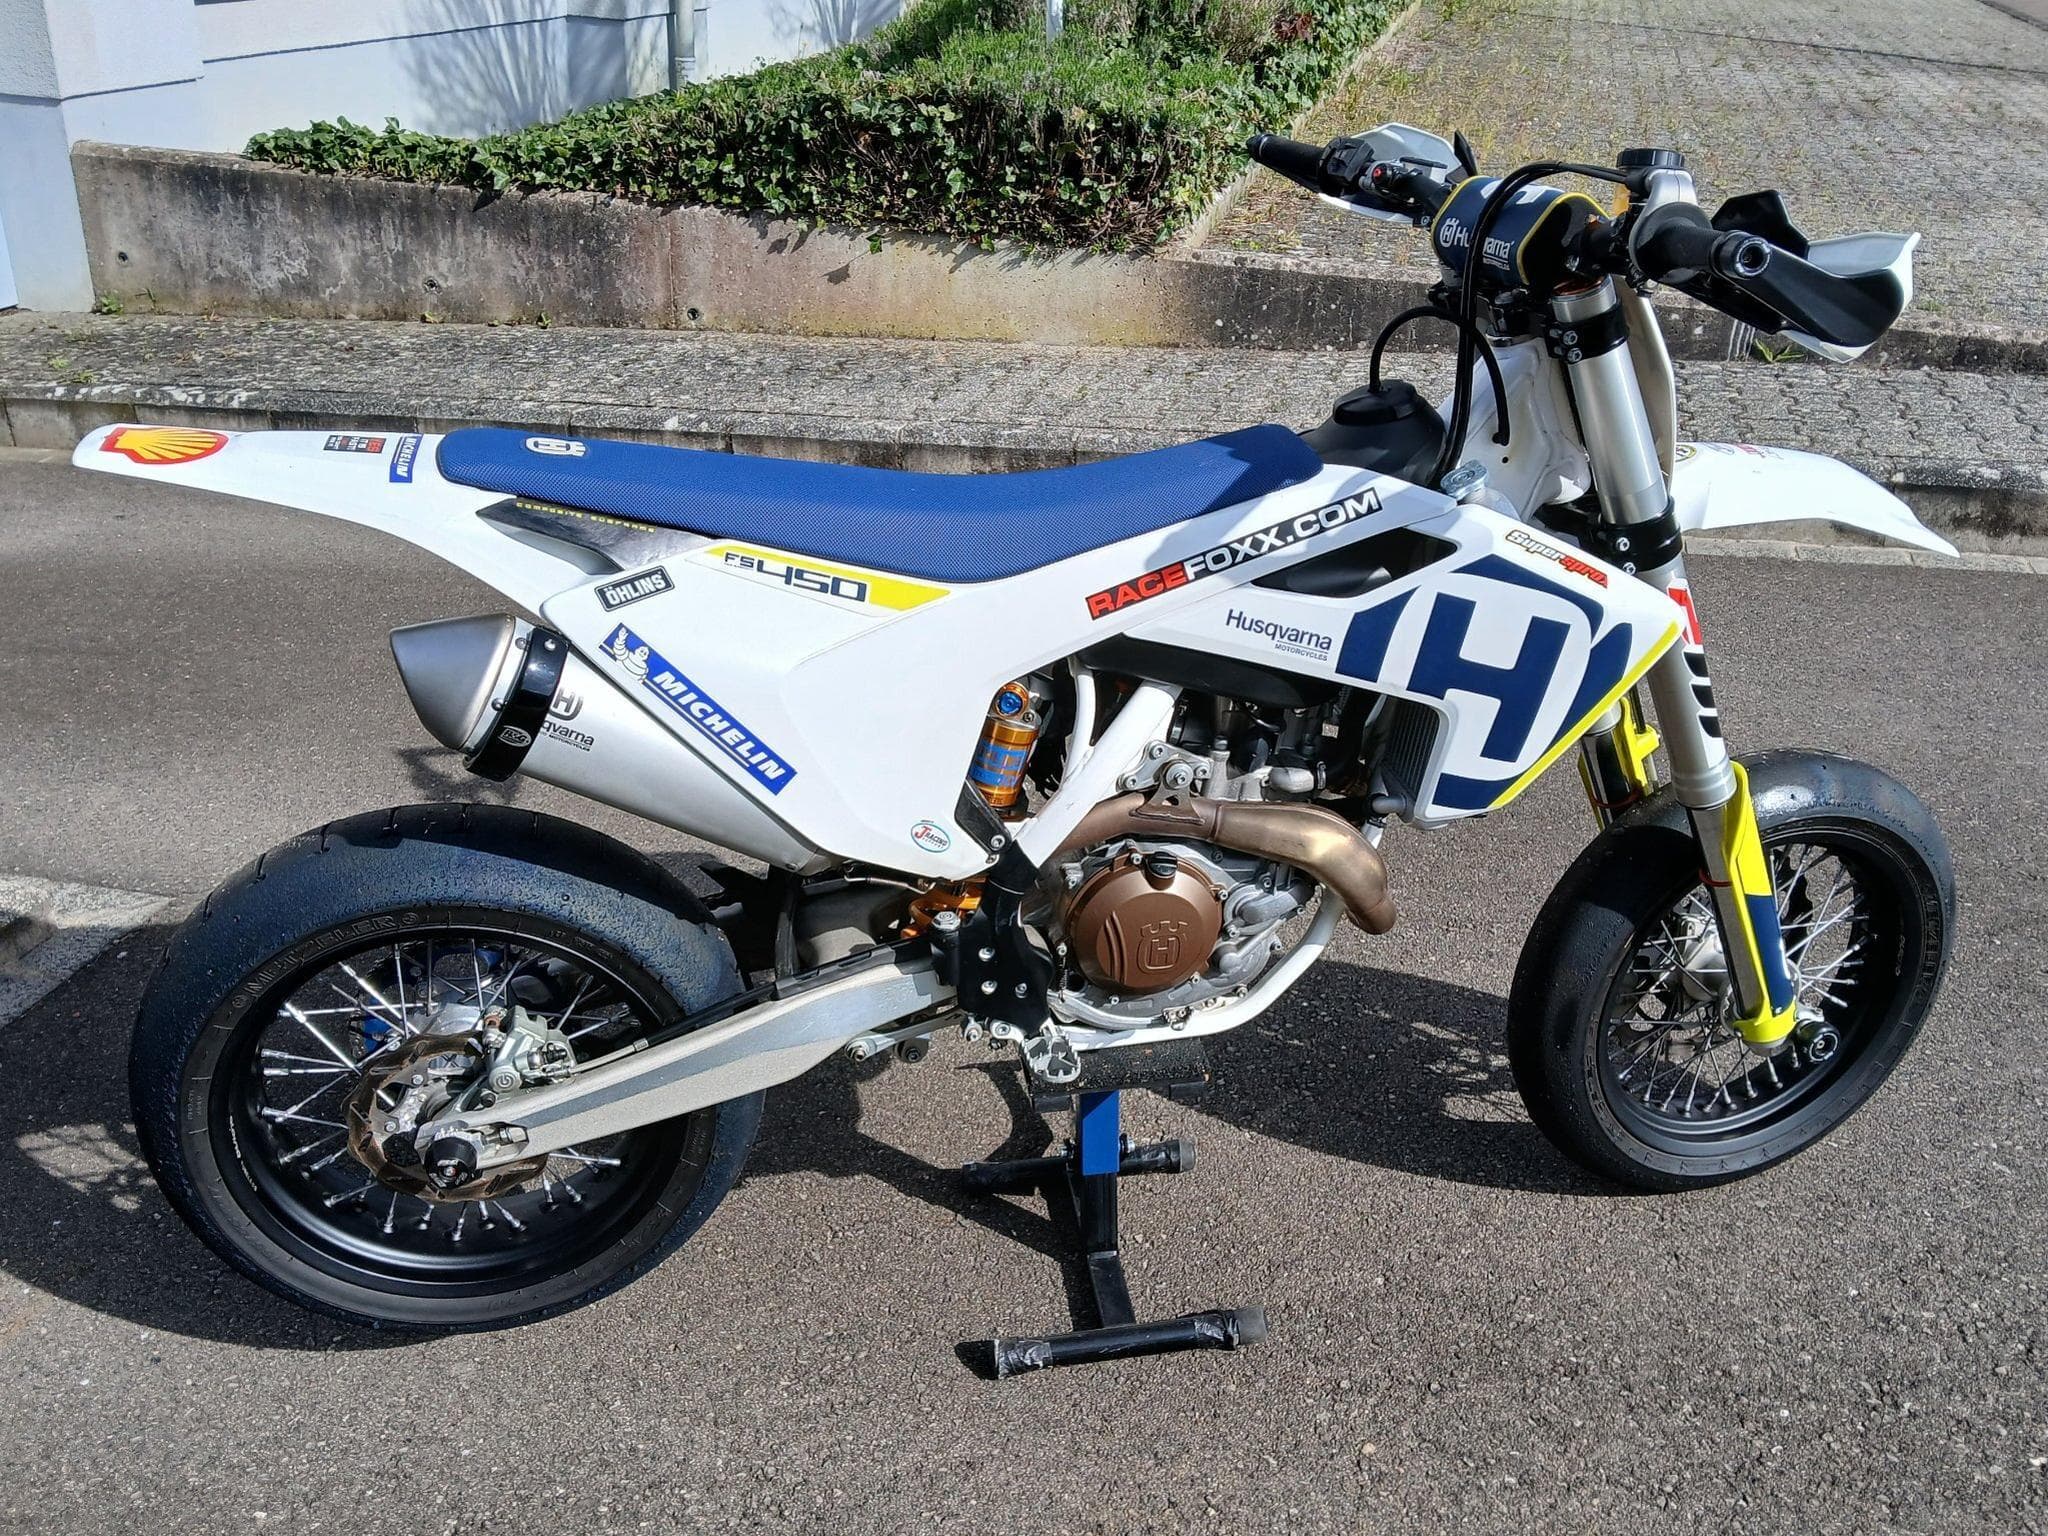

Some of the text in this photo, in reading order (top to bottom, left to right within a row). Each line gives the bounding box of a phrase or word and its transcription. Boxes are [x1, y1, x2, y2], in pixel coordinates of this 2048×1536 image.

[1087, 490, 1380, 618] RACEFOXX.COM
[605, 573, 667, 606] ÖHLINS
[757, 559, 868, 603] 450
[1225, 608, 1333, 651] Husqvarna
[1274, 642, 1329, 662] MOTORCYCLES
[541, 720, 595, 747] qvarna
[652, 670, 787, 781] MICHELIN
